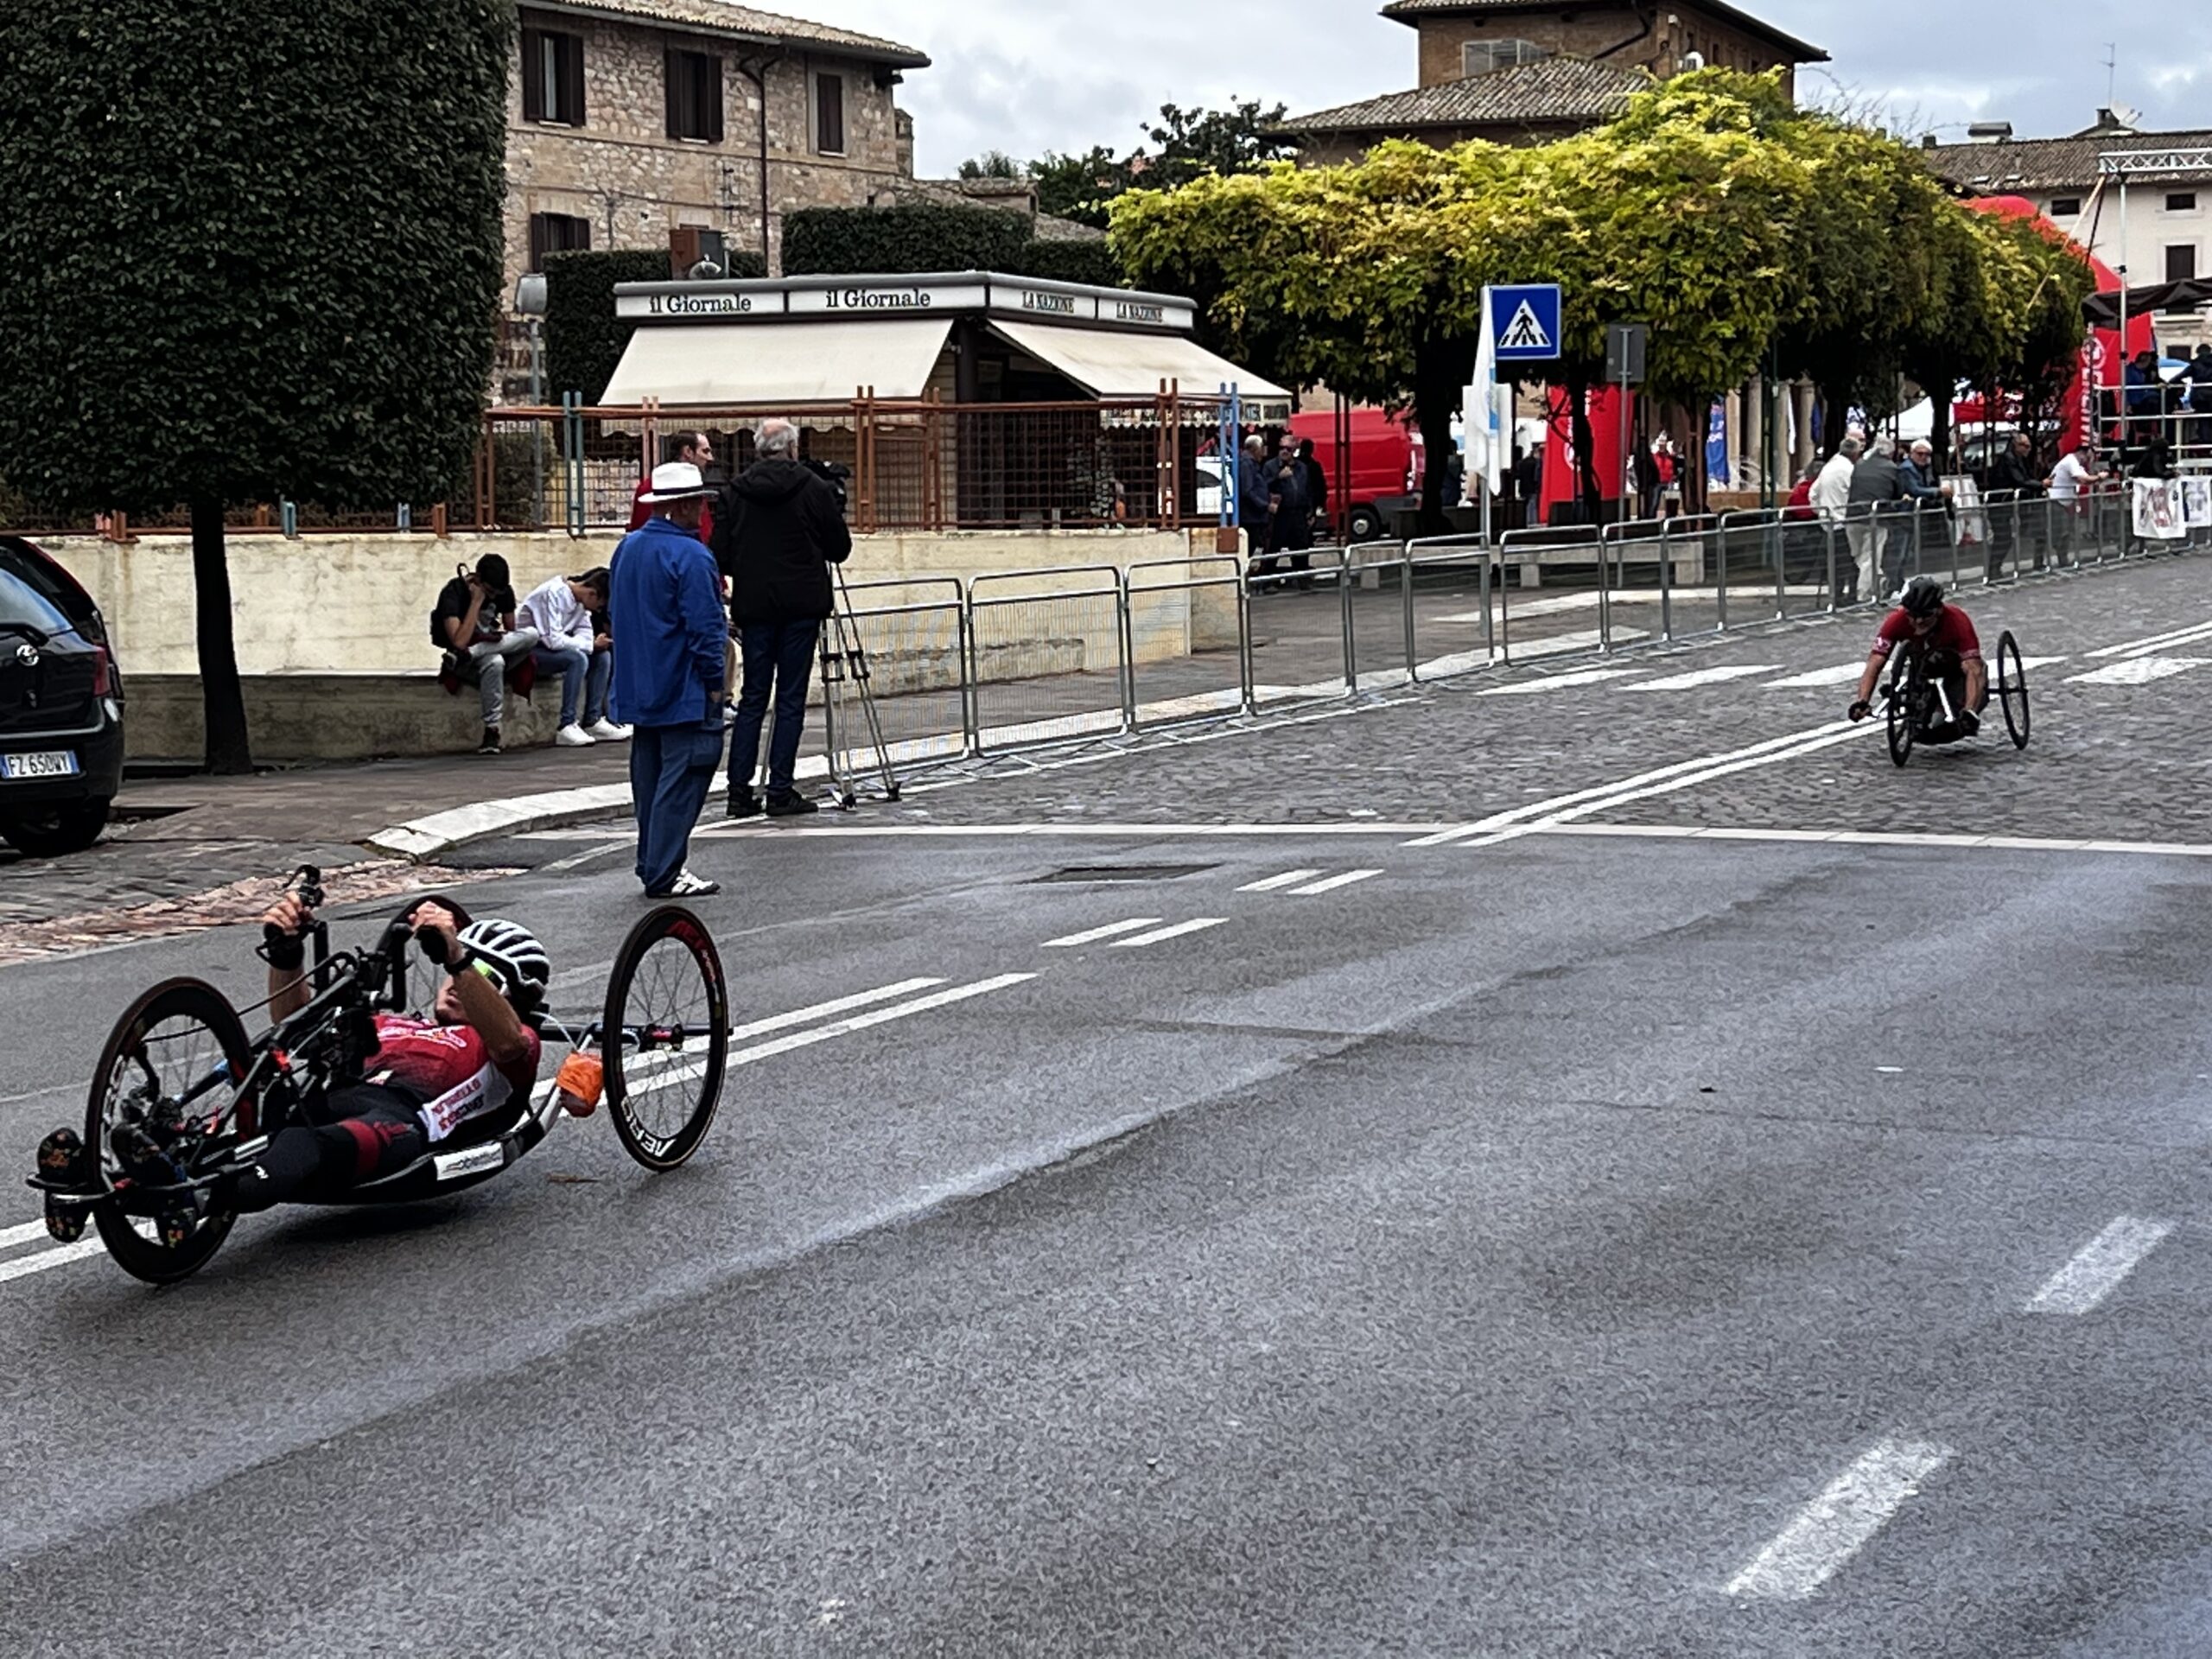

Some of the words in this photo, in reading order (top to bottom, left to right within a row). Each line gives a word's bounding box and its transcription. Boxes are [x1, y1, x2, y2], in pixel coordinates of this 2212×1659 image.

[649, 295, 663, 313] il
[667, 294, 752, 313] Giornale
[826, 289, 838, 308] il
[843, 288, 931, 308] Giornale
[1021, 291, 1034, 308] LA
[1036, 294, 1075, 314] NAZIONE
[1116, 302, 1127, 319] LA
